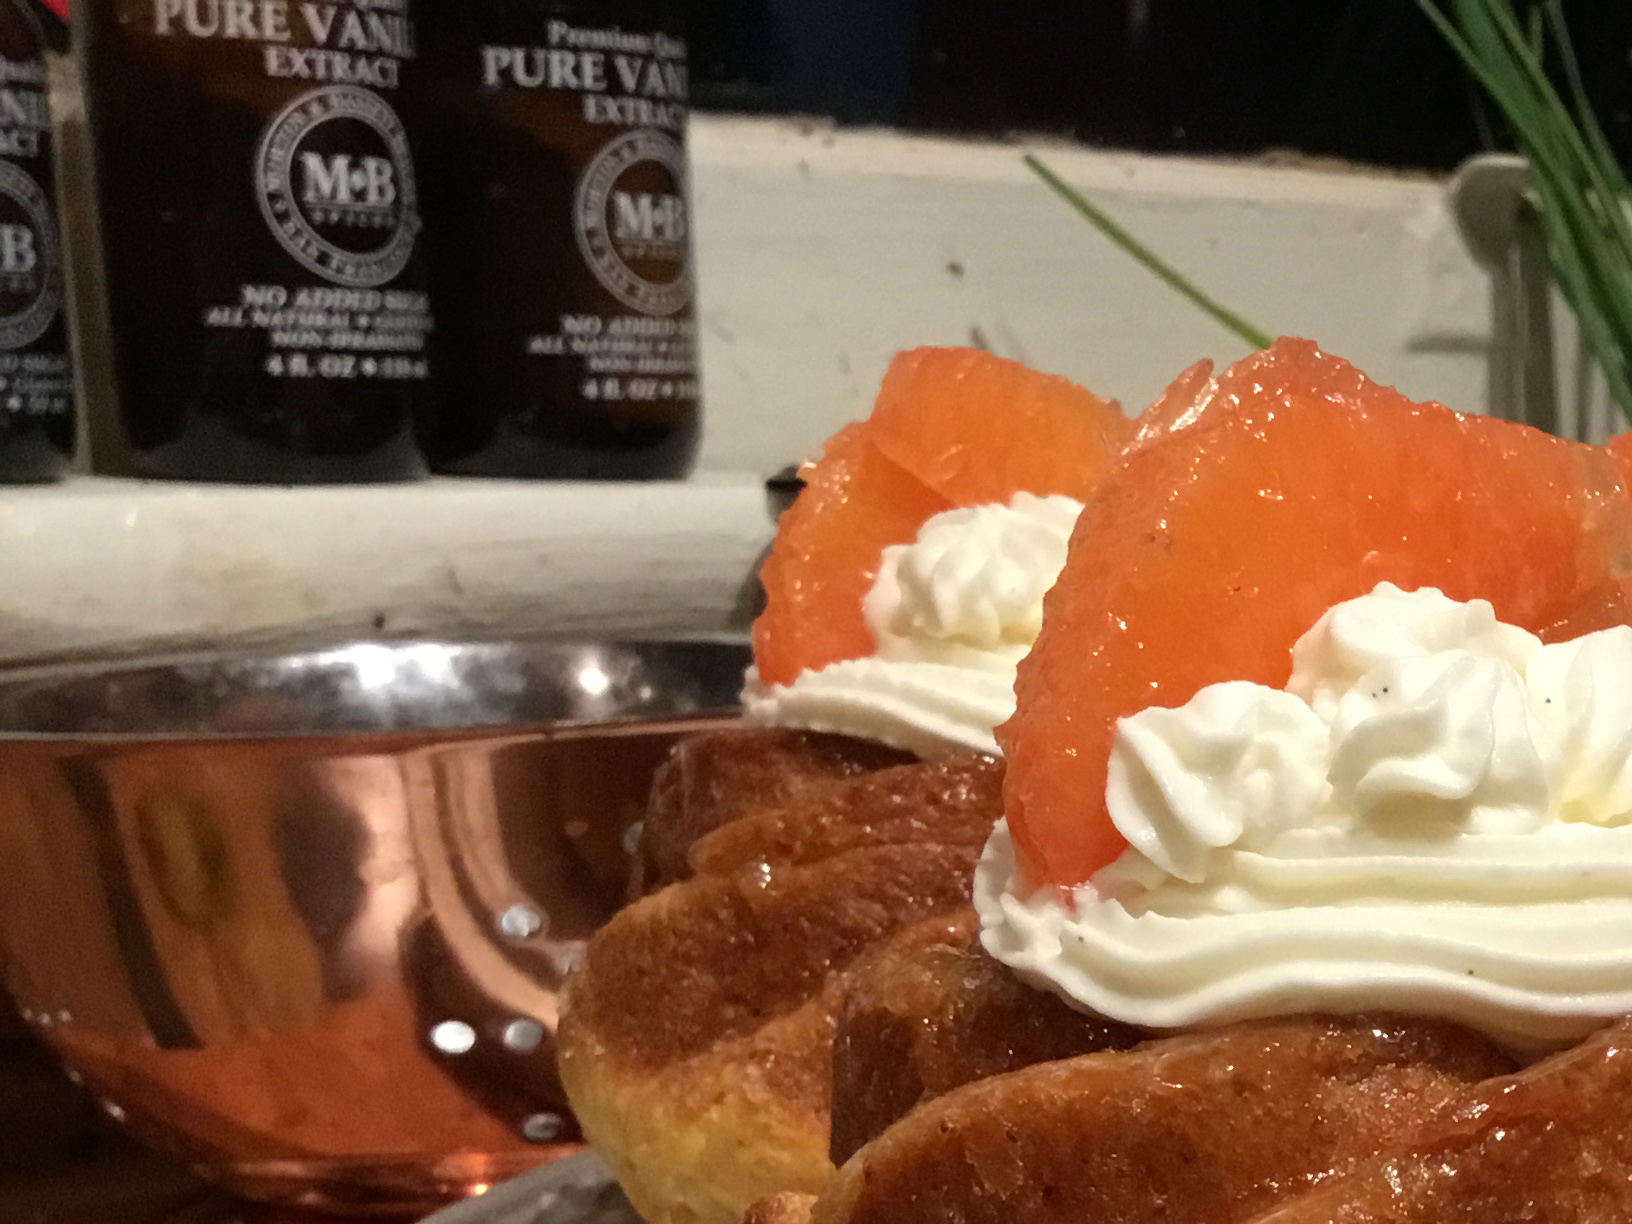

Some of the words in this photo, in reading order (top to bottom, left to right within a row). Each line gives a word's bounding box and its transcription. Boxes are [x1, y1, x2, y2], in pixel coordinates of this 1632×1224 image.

[153, 0, 292, 41] PURE
[481, 46, 608, 91] PURE
[241, 284, 288, 306] NO
[204, 305, 246, 327] ALL
[561, 315, 602, 334] NO
